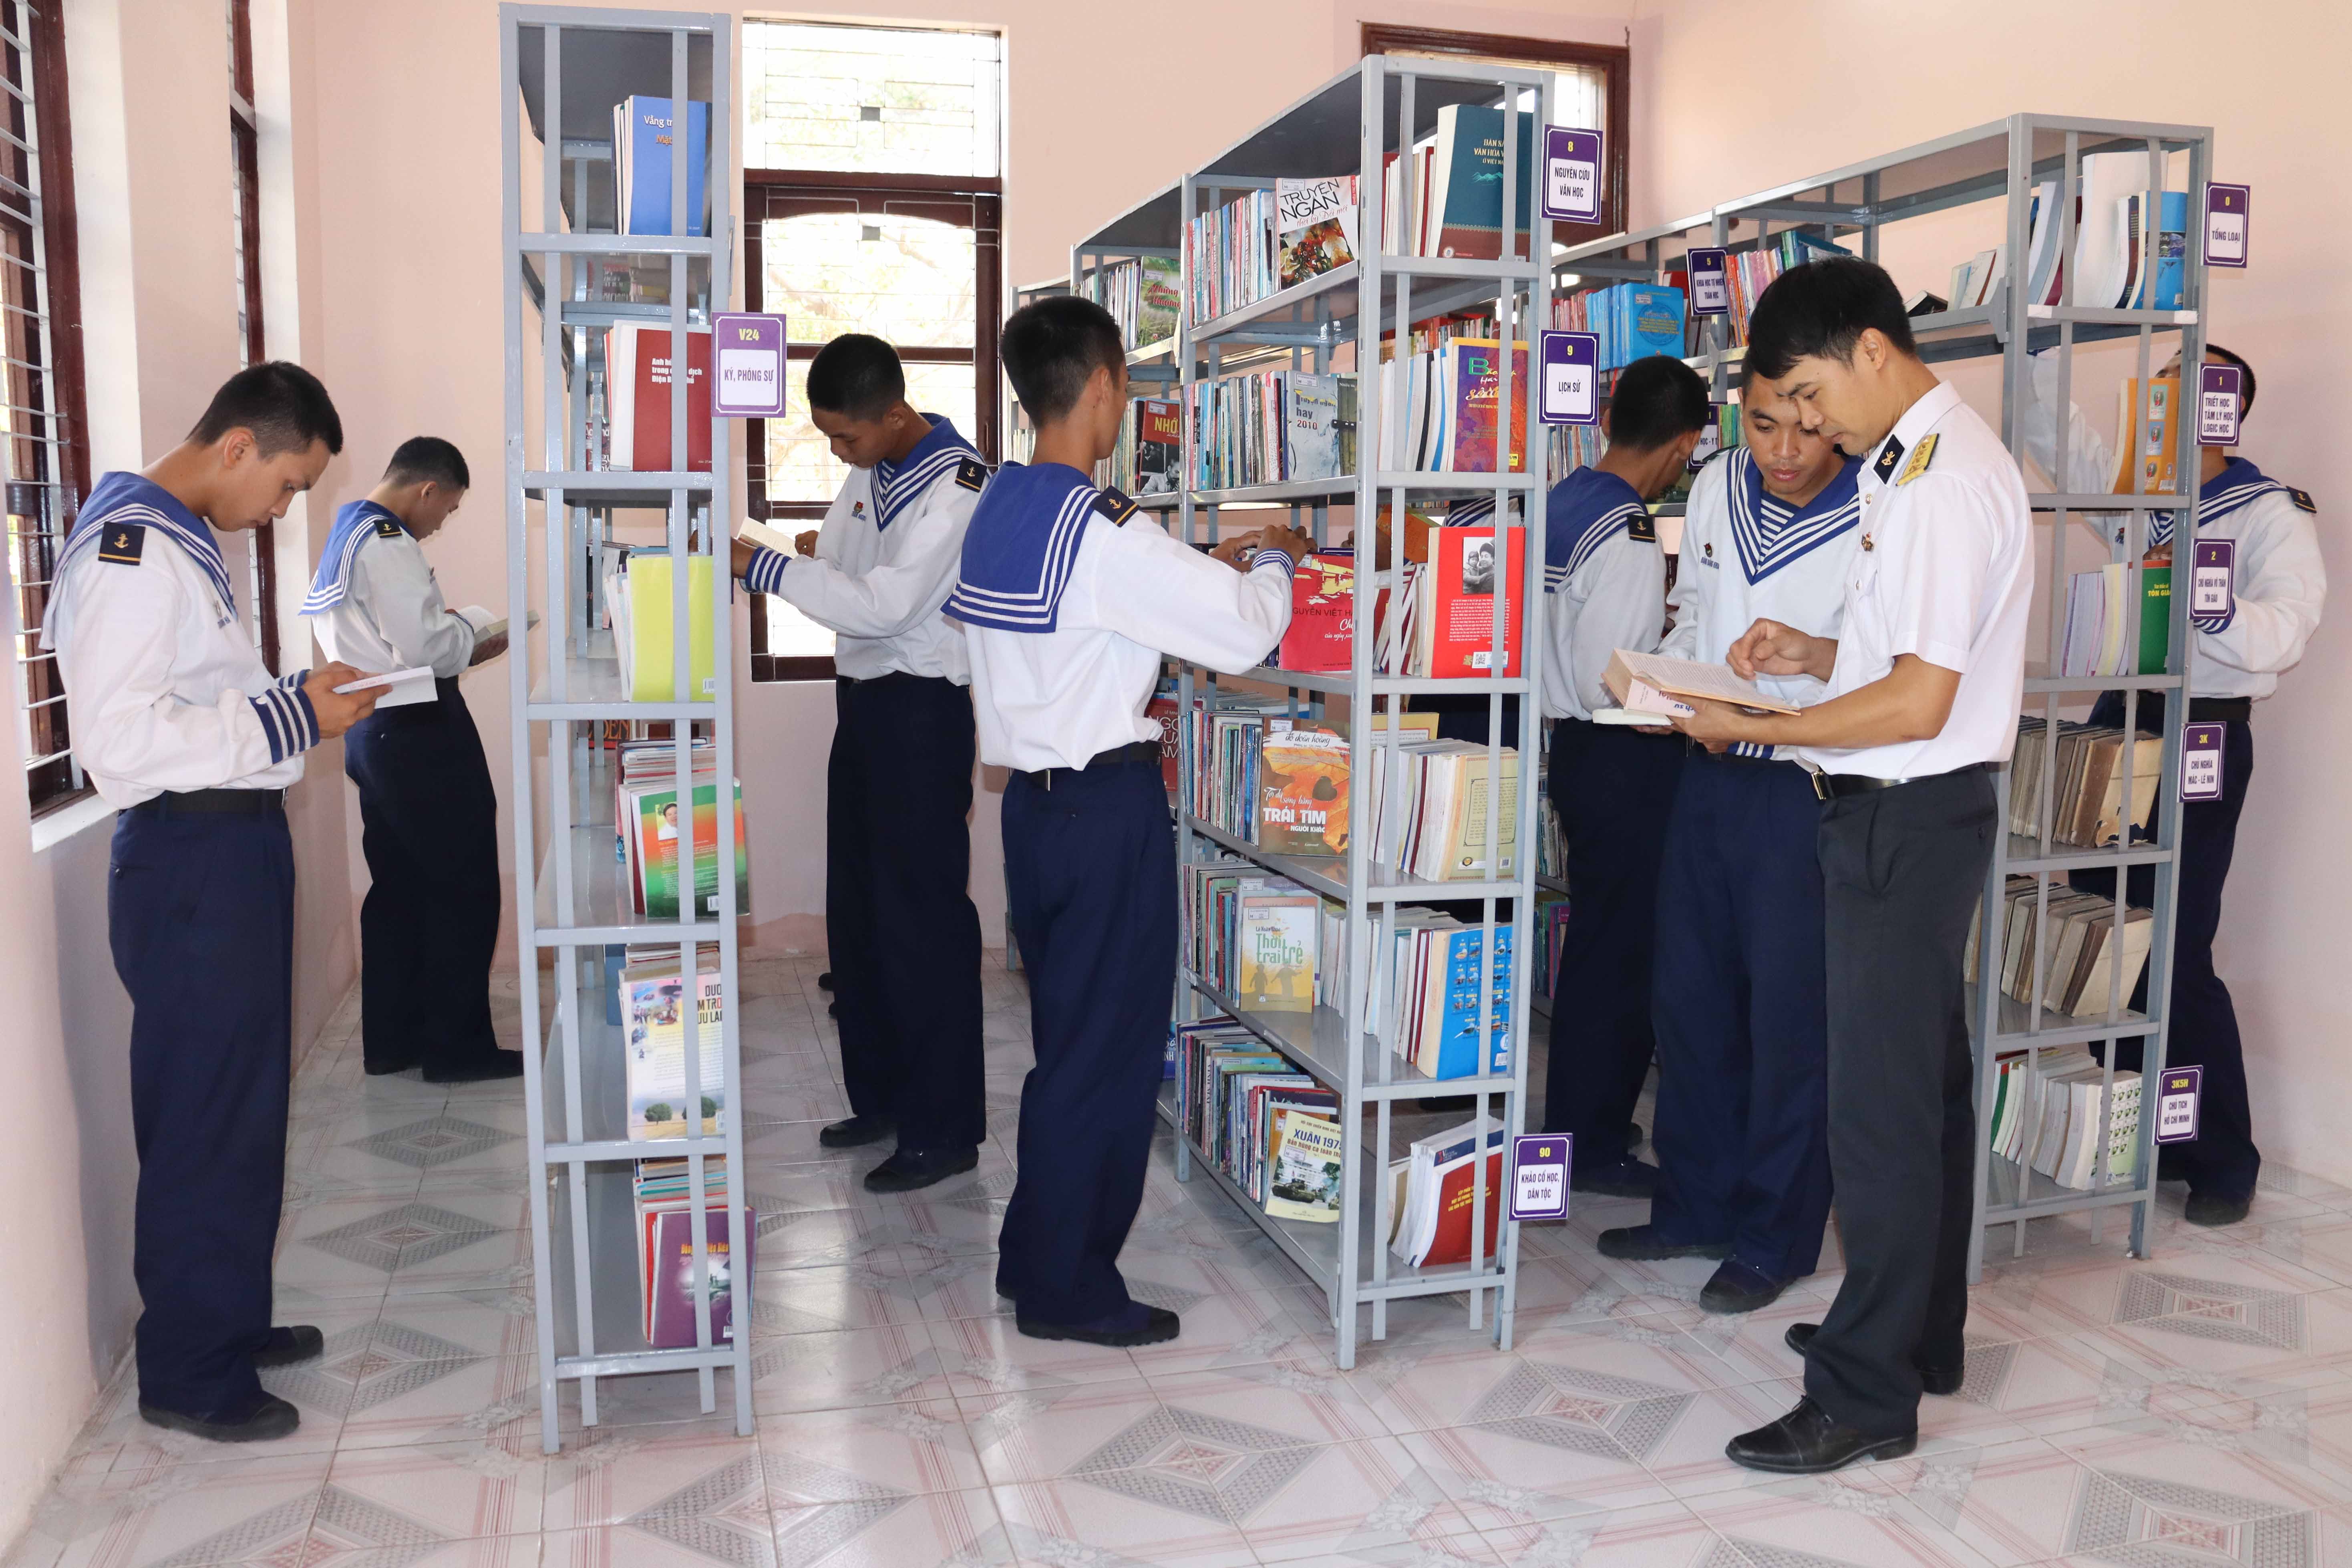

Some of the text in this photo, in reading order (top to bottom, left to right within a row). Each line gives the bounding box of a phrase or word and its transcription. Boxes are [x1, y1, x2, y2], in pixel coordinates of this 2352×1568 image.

[1567, 141, 1574, 152] 8
[1555, 167, 1577, 179] NGUYÊN
[1560, 184, 1583, 199] VĂN HỌC
[2225, 196, 2230, 206] 0
[2228, 231, 2240, 244] LOẠI
[1706, 258, 1711, 266] 5
[738, 328, 760, 341] V24
[1567, 345, 1573, 356] 9
[688, 368, 702, 376] dịch
[724, 367, 774, 384] KÝ, PHÓNG SỰ
[1558, 379, 1581, 394] LỊCH SỬ
[2219, 376, 2223, 386] 1
[2205, 395, 2229, 409] TRIẾT HỌC
[1296, 407, 1313, 419] hay
[2205, 409, 2233, 423] TÂM LÝ HỌC
[1297, 420, 1317, 430] 2010
[2204, 423, 2229, 435] LOGIC HỌC
[2211, 551, 2216, 560] 2
[1293, 606, 1343, 617] GUYỄN VIỆT
[2199, 734, 2208, 744] 3K
[1263, 806, 1326, 825] TRÁI TIM
[2171, 1079, 2189, 1089] 3K5H
[2178, 1101, 2187, 1111] TỊCH
[2179, 1114, 2190, 1123] MINH
[1294, 1129, 1321, 1145] XUÂN
[1539, 1147, 1551, 1157] 90
[1521, 1171, 1536, 1183] KHẢO
[1527, 1187, 1551, 1201] DÂN TỘC
